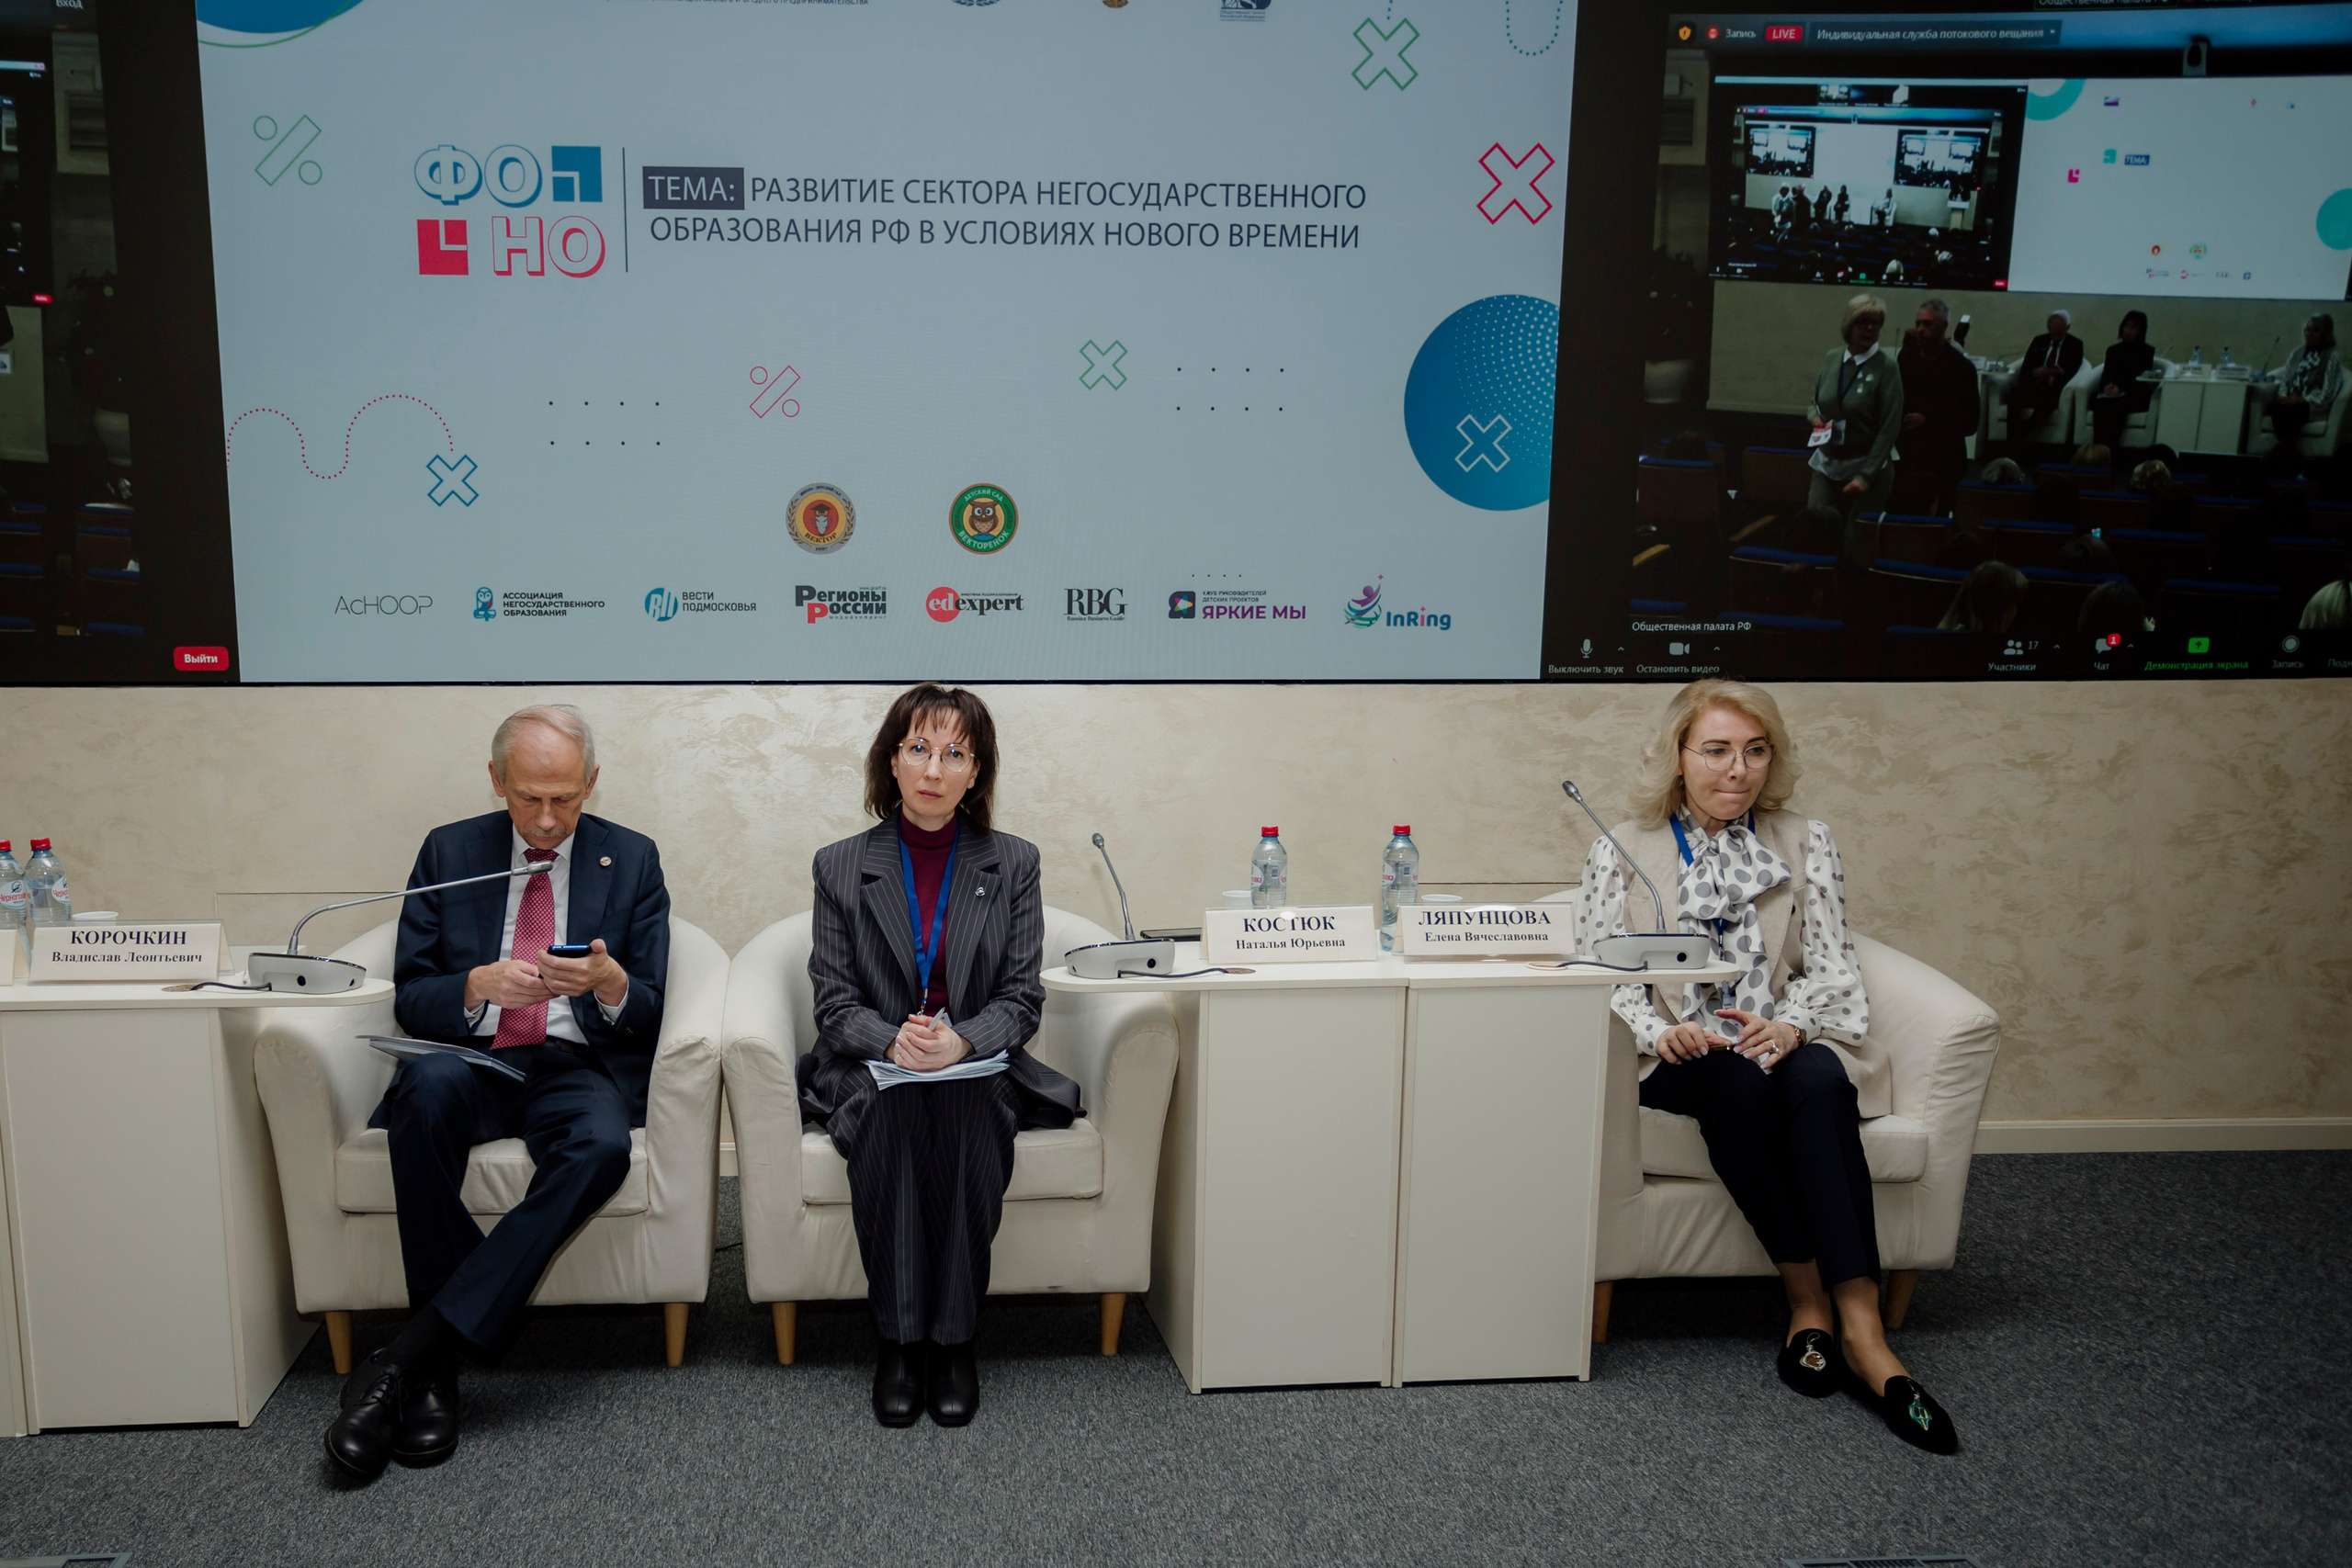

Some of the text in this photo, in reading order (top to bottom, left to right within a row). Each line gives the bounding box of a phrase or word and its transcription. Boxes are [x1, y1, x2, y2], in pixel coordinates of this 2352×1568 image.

[1725, 28, 1757, 39] Запись
[1772, 28, 1796, 39] LIVE
[1817, 28, 2043, 41] Индивидуальная служба потокового вещания
[648, 175, 1367, 212] ТЕМА: РАЗВИТИЕ СЕКТОРА НЕГОСУДАРСТВЕННОГО
[650, 217, 1360, 249] ОБРАЗОВАНИЯ РФ В УСЛОВИЯХ НОВОГО ВРЕМЕНИ
[964, 489, 991, 502] ДЕТСКИЙ
[804, 532, 837, 544] ВЕКТОР
[503, 592, 563, 601] АССОЦИАЦИЯ
[795, 584, 887, 607] Регионы
[1063, 587, 1128, 616] RBG
[503, 600, 605, 609] НЕГОСУДАРСТВЕННОГО
[503, 609, 567, 617] ОБРАЗОВАНИЯ
[807, 603, 887, 624] России
[1202, 605, 1306, 620] ЯРКИЕ МЫ
[1385, 607, 1452, 631] InRing
[1631, 621, 1752, 632] Общественная палата РФ
[2028, 640, 2039, 650] 17
[2110, 636, 2117, 645] 1
[184, 653, 218, 663] Выйти
[2271, 659, 2304, 669] Запись
[1548, 664, 1624, 675] Выключить звук
[1636, 664, 1720, 675] Остановить видео
[1988, 662, 2037, 672] Участники
[2093, 661, 2110, 671] Чат
[2144, 660, 2249, 672] Демонстрация экрана
[1242, 916, 1336, 932] КОСТЮК
[1418, 910, 1552, 928] ЛЯПУНЦОВА
[70, 930, 187, 945] КОРОЧКИН
[1425, 931, 1549, 942] Елена Вячеславовна
[1236, 938, 1346, 951] Наталья Юрьевна
[51, 951, 203, 964] Владислав Леонтьевич
